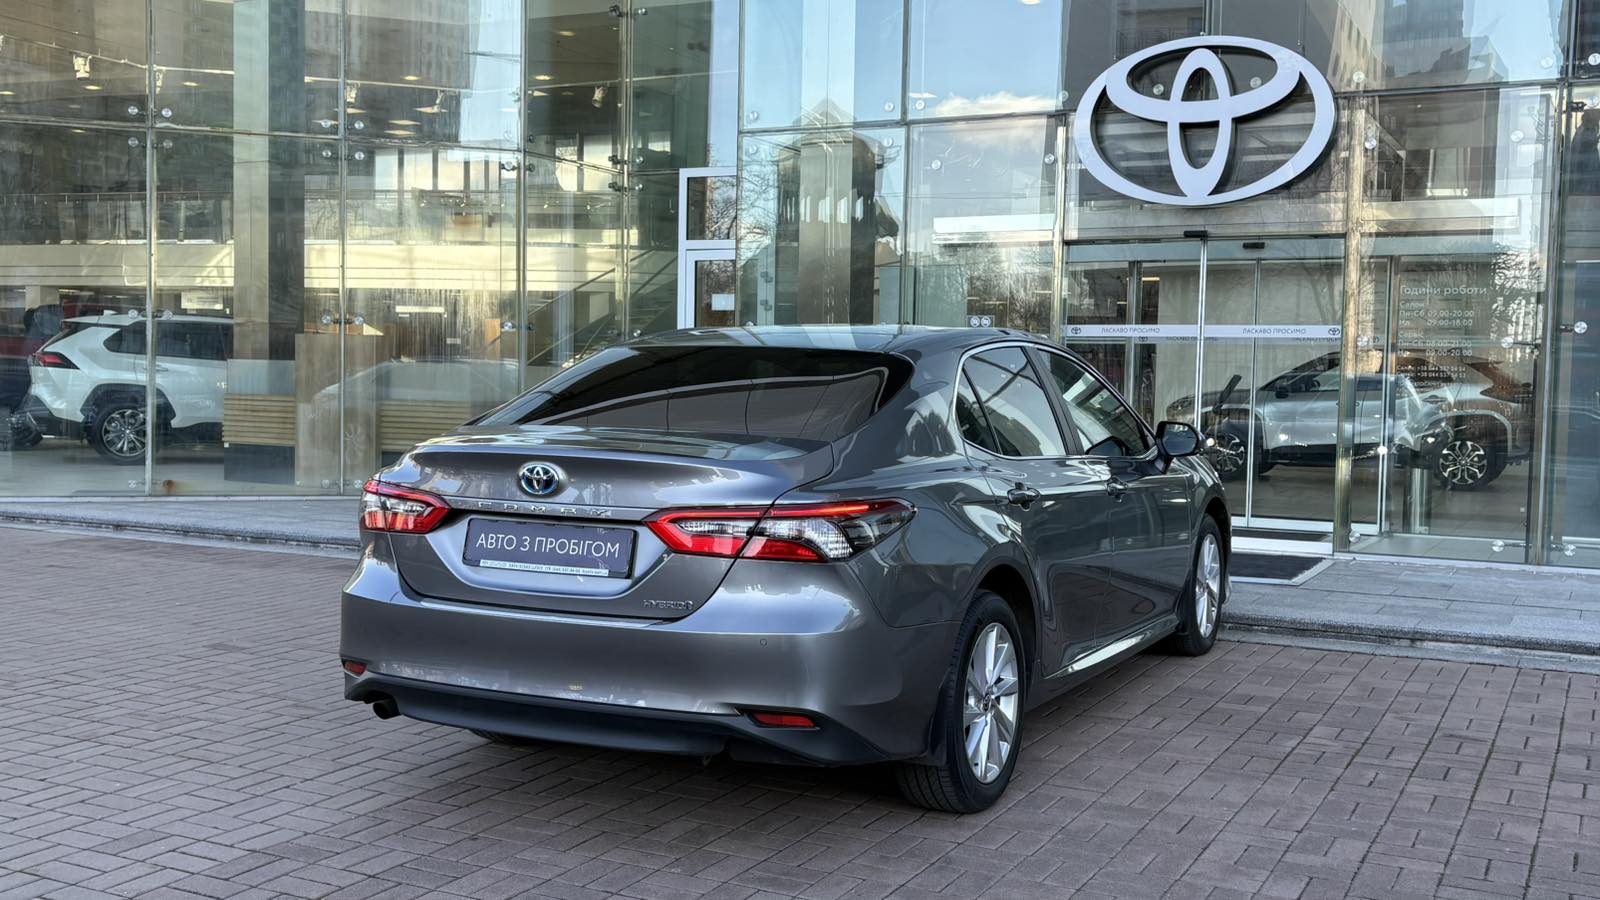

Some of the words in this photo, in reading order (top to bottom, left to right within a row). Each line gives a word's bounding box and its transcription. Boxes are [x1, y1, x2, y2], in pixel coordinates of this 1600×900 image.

[1400, 285, 1441, 296] Години
[1444, 284, 1488, 296] роботи
[475, 533, 517, 550] АВТО
[519, 535, 530, 551] З
[534, 537, 620, 558] ПРОБІГОМ
